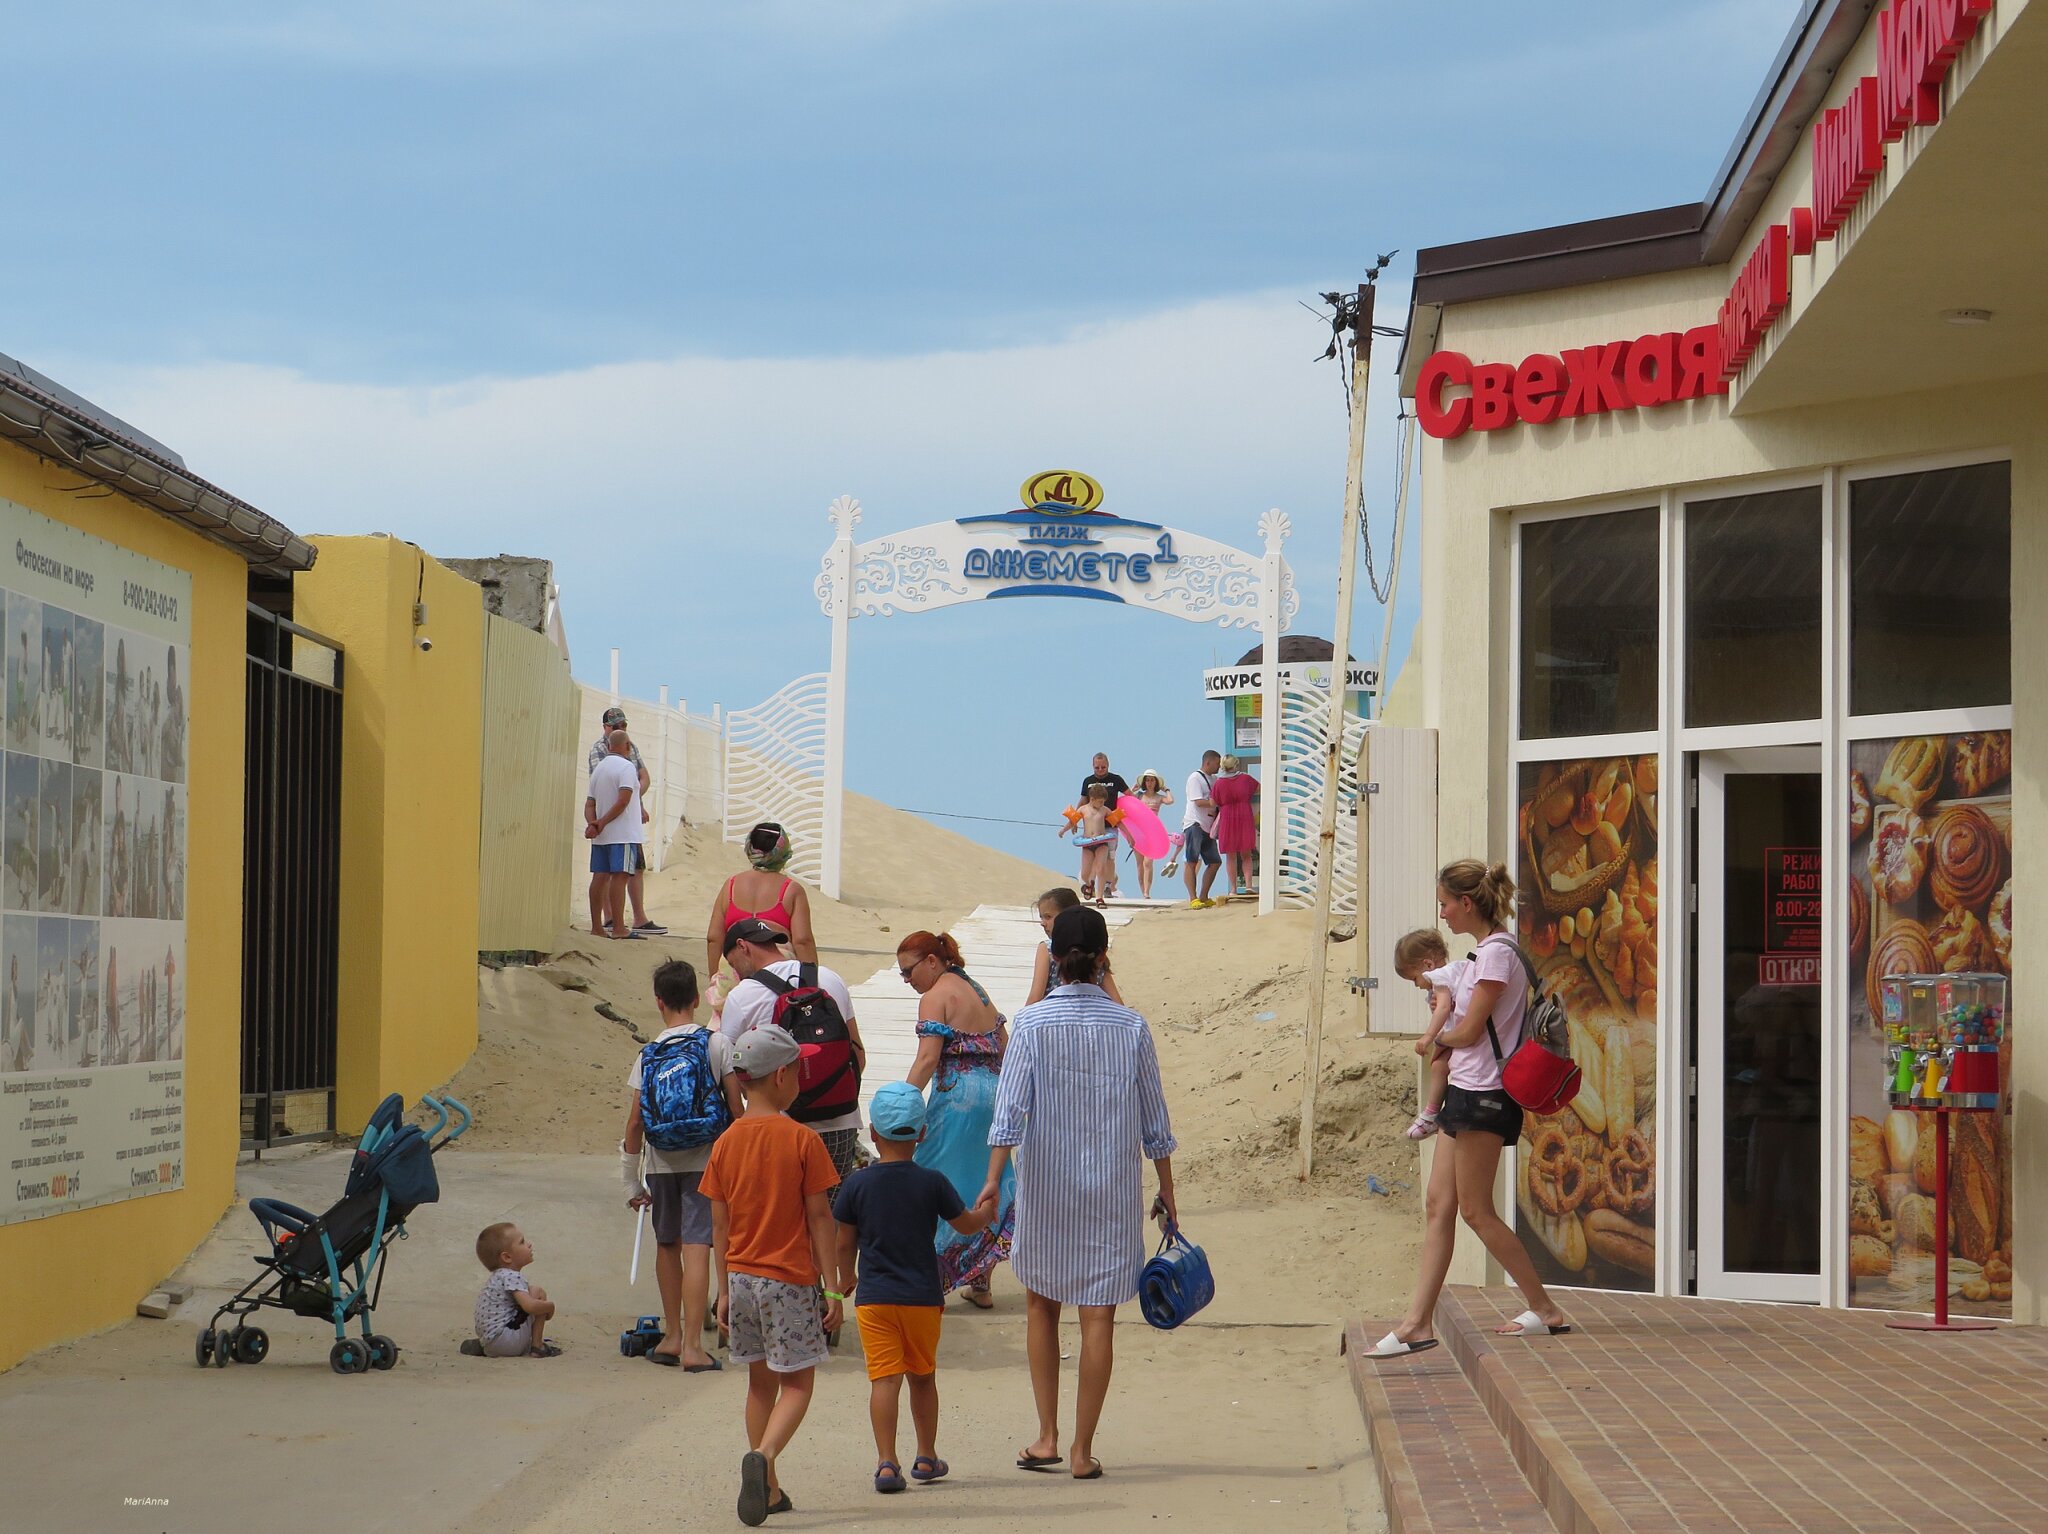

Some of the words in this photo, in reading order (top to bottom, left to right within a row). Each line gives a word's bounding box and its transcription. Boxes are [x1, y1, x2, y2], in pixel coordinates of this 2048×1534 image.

[1876, 0, 1992, 143] Марке
[1415, 324, 1728, 438] Свежая
[963, 547, 1152, 583] ДЖЕМЕТЕ
[1153, 532, 1179, 564] 1
[1029, 525, 1089, 540] ПЛЯЖ
[16, 537, 62, 582] Фотосессии
[63, 564, 74, 585] на
[75, 568, 95, 599] море
[657, 1061, 688, 1082] Supreme
[17, 1178, 49, 1201] Стоимость
[51, 1173, 67, 1198] 4000
[68, 1169, 80, 1199] руб
